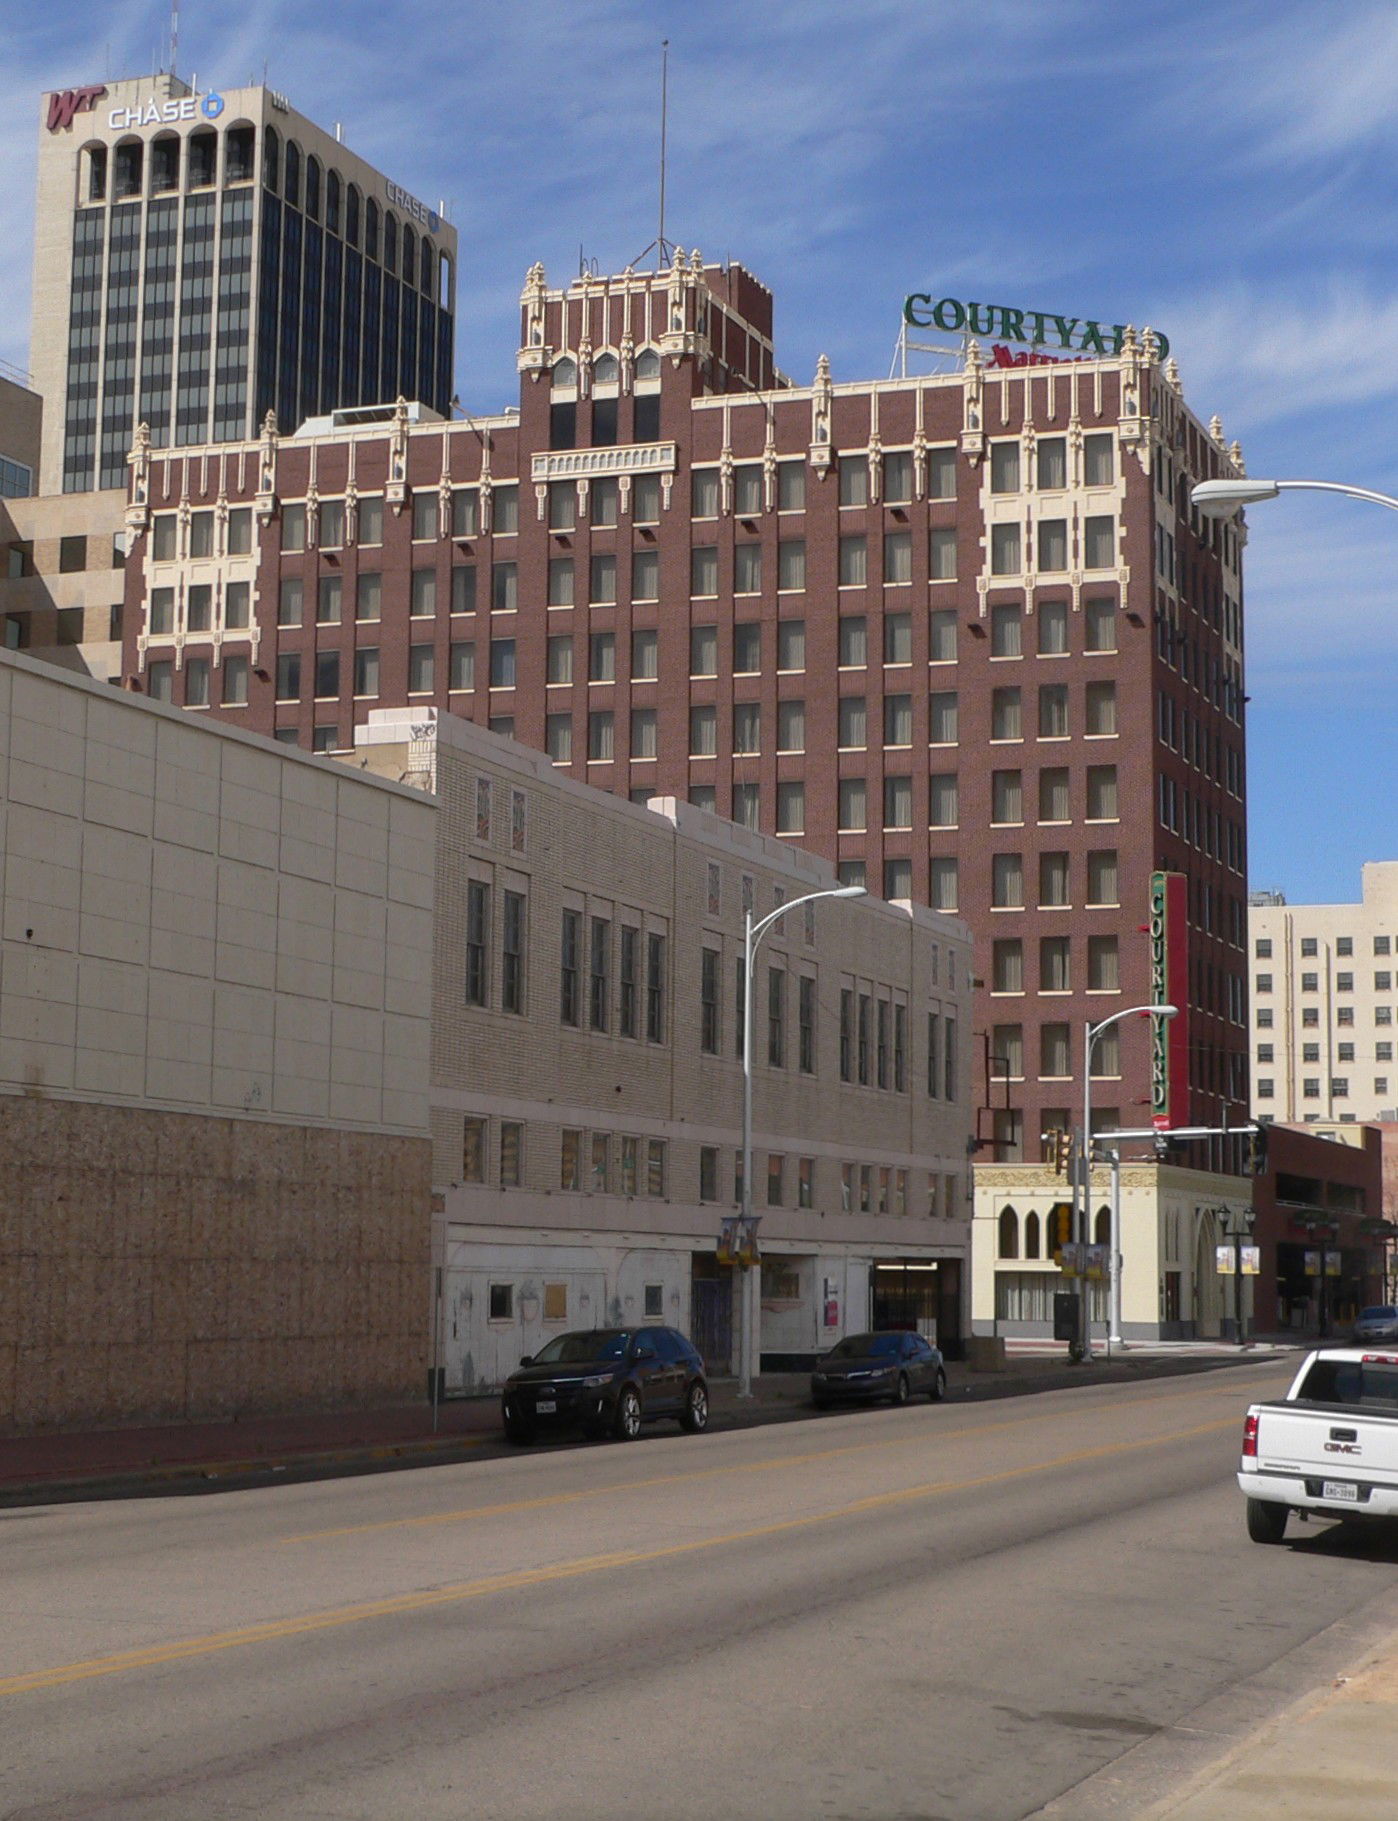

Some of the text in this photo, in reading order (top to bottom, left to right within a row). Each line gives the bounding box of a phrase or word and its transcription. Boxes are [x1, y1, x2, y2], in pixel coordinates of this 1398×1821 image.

[47, 86, 106, 130] WT
[109, 98, 197, 130] CHASE
[386, 179, 429, 226] CHASE
[1150, 893, 1164, 1106] COURTYARD
[1323, 1442, 1362, 1455] GMC
